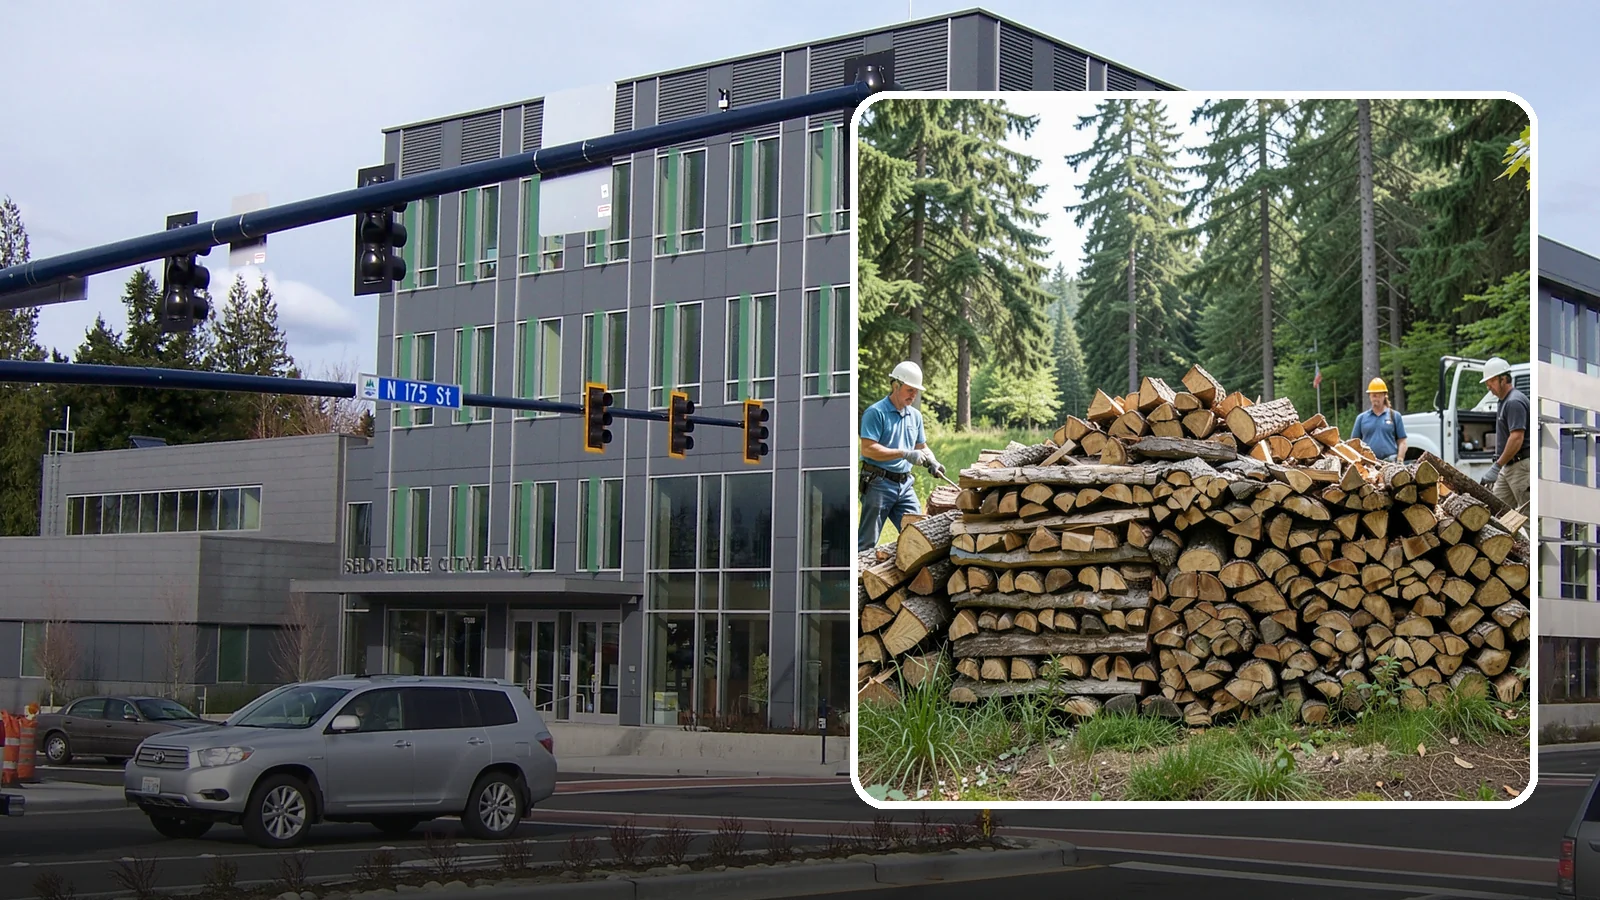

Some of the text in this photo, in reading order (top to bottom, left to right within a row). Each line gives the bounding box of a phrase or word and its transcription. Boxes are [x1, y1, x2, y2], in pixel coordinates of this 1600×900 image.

[387, 381, 451, 405] N 175 St
[344, 556, 526, 573] SHORELINE CITY HALL
